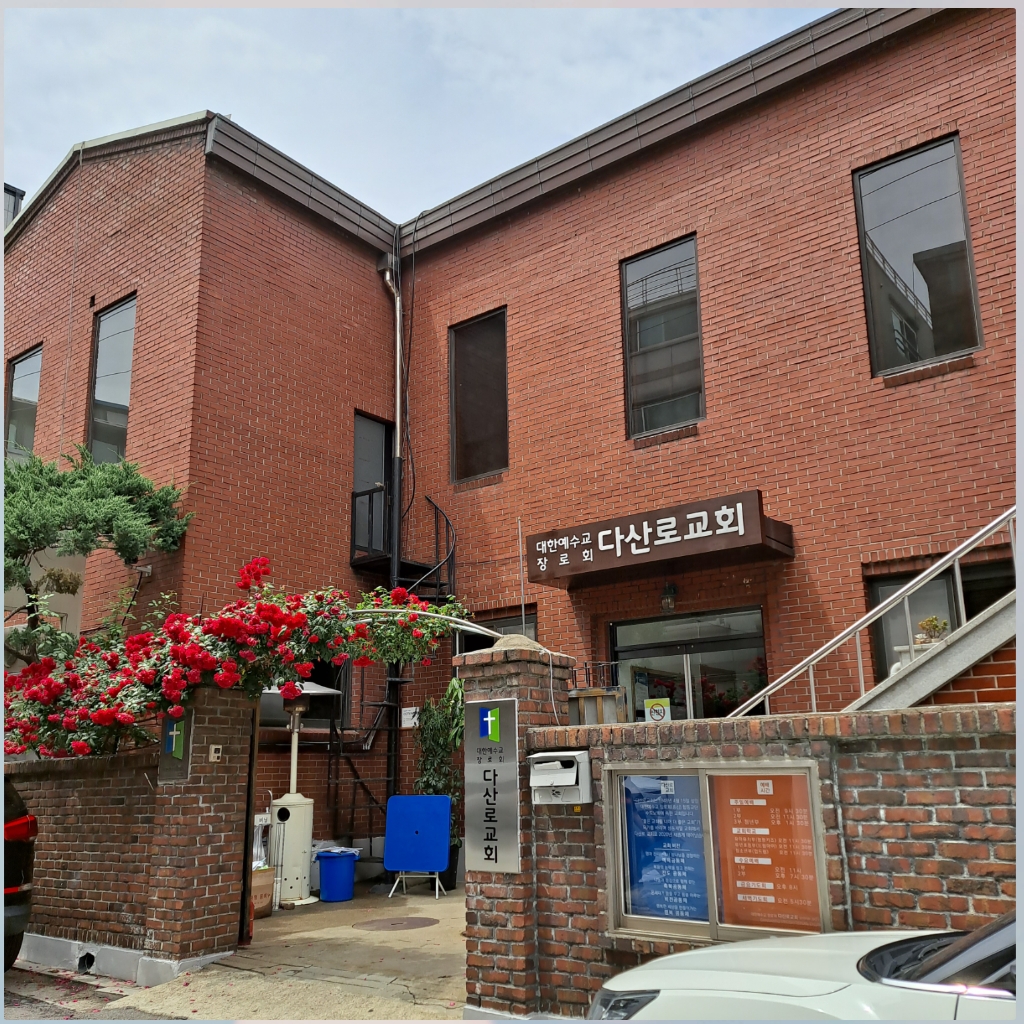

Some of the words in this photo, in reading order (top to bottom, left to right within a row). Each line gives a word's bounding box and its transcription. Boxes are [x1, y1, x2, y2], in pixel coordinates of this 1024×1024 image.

[536, 532, 592, 554] 대한예수교
[598, 502, 745, 557] 다산로교회
[477, 747, 504, 755] 대한예수교
[483, 769, 498, 863] 다산로교회
